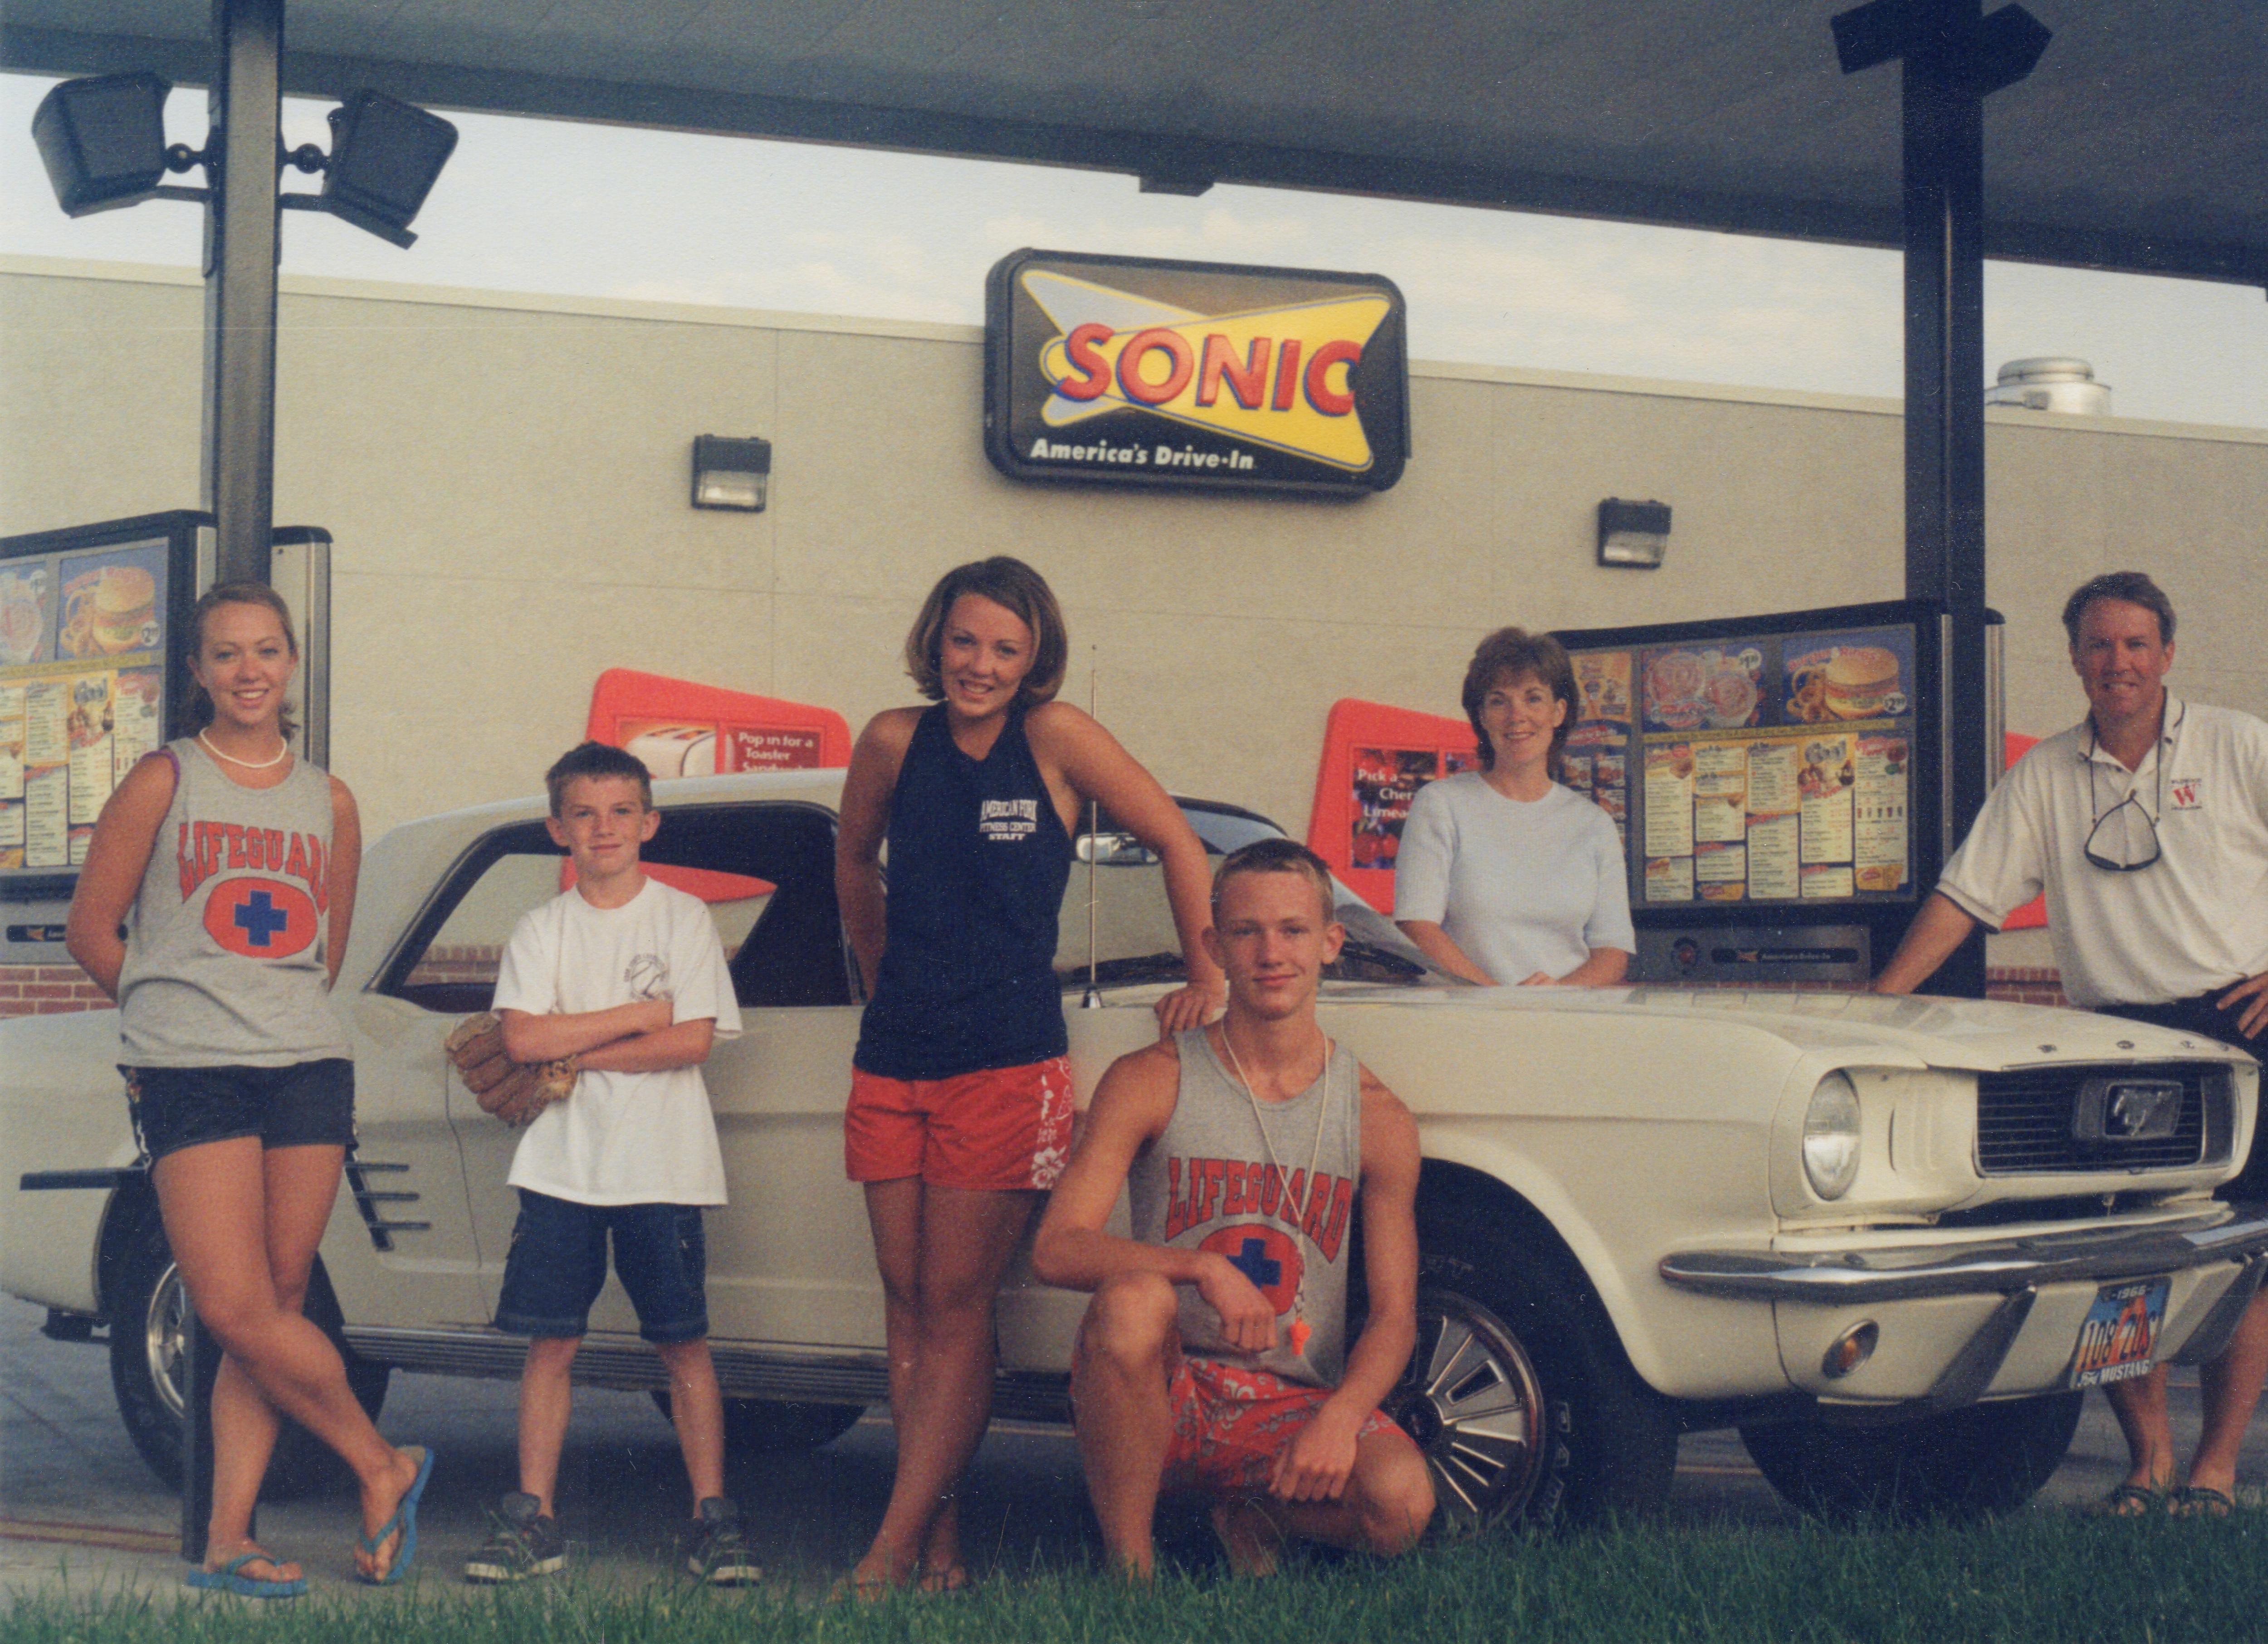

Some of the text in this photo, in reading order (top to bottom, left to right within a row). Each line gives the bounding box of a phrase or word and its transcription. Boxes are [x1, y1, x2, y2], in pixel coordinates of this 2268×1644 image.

[1054, 322, 1363, 417] SONIC
[1030, 439, 1255, 470] America's Drive-In
[739, 732, 813, 747] Pop in for a
[746, 747, 791, 761] Toaster
[1358, 769, 1398, 782] Pick a
[1379, 787, 1413, 800] Cher
[1364, 804, 1409, 819] Limea
[988, 833, 1026, 841] STAFF
[1165, 1156, 1353, 1264] LIFEGUARD
[2100, 1359, 2151, 1383] MUSTANG
